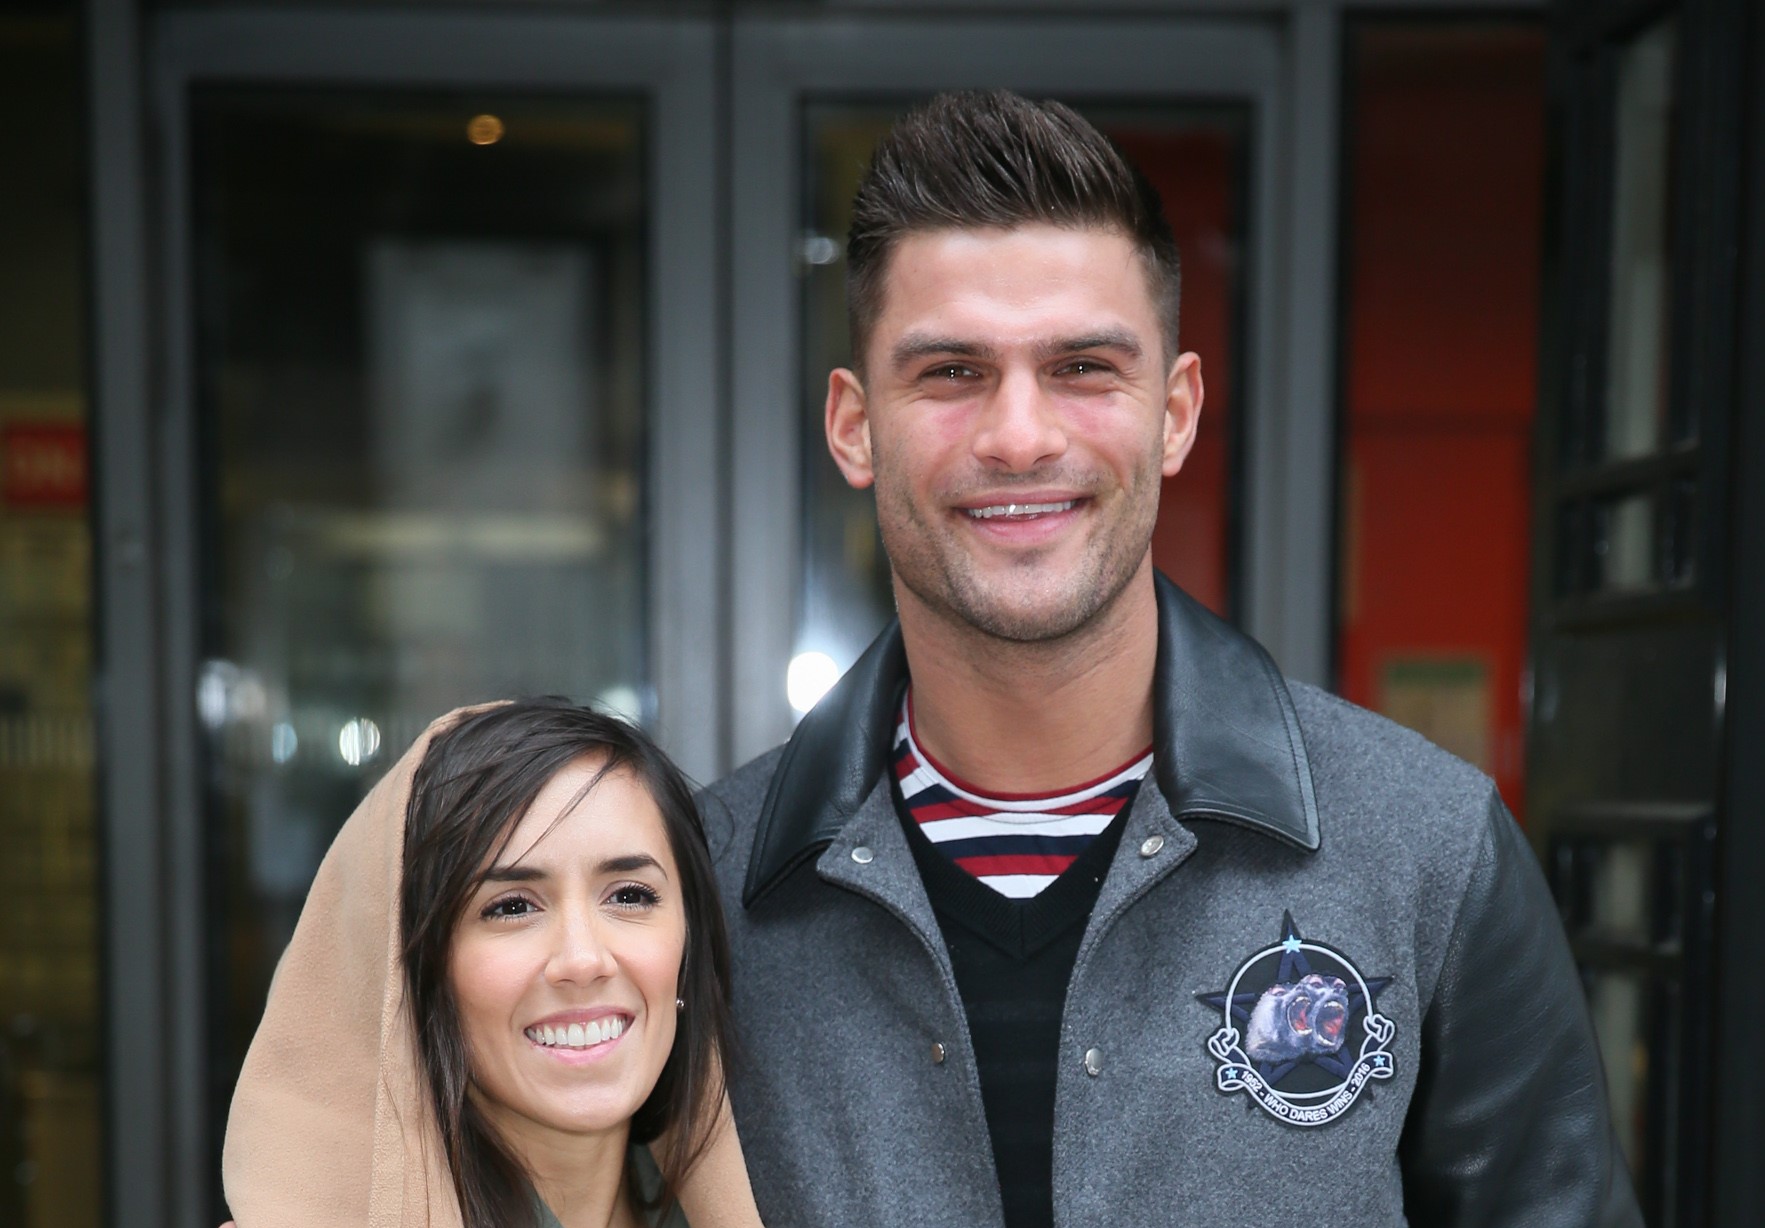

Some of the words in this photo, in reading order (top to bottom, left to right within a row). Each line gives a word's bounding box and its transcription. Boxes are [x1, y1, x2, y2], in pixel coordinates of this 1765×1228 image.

[1241, 1071, 1263, 1093] 1952
[1264, 1094, 1289, 1116] WHO
[1290, 1110, 1328, 1122] DARES
[1327, 1092, 1353, 1115] WINS
[1351, 1063, 1371, 1087] 2016
